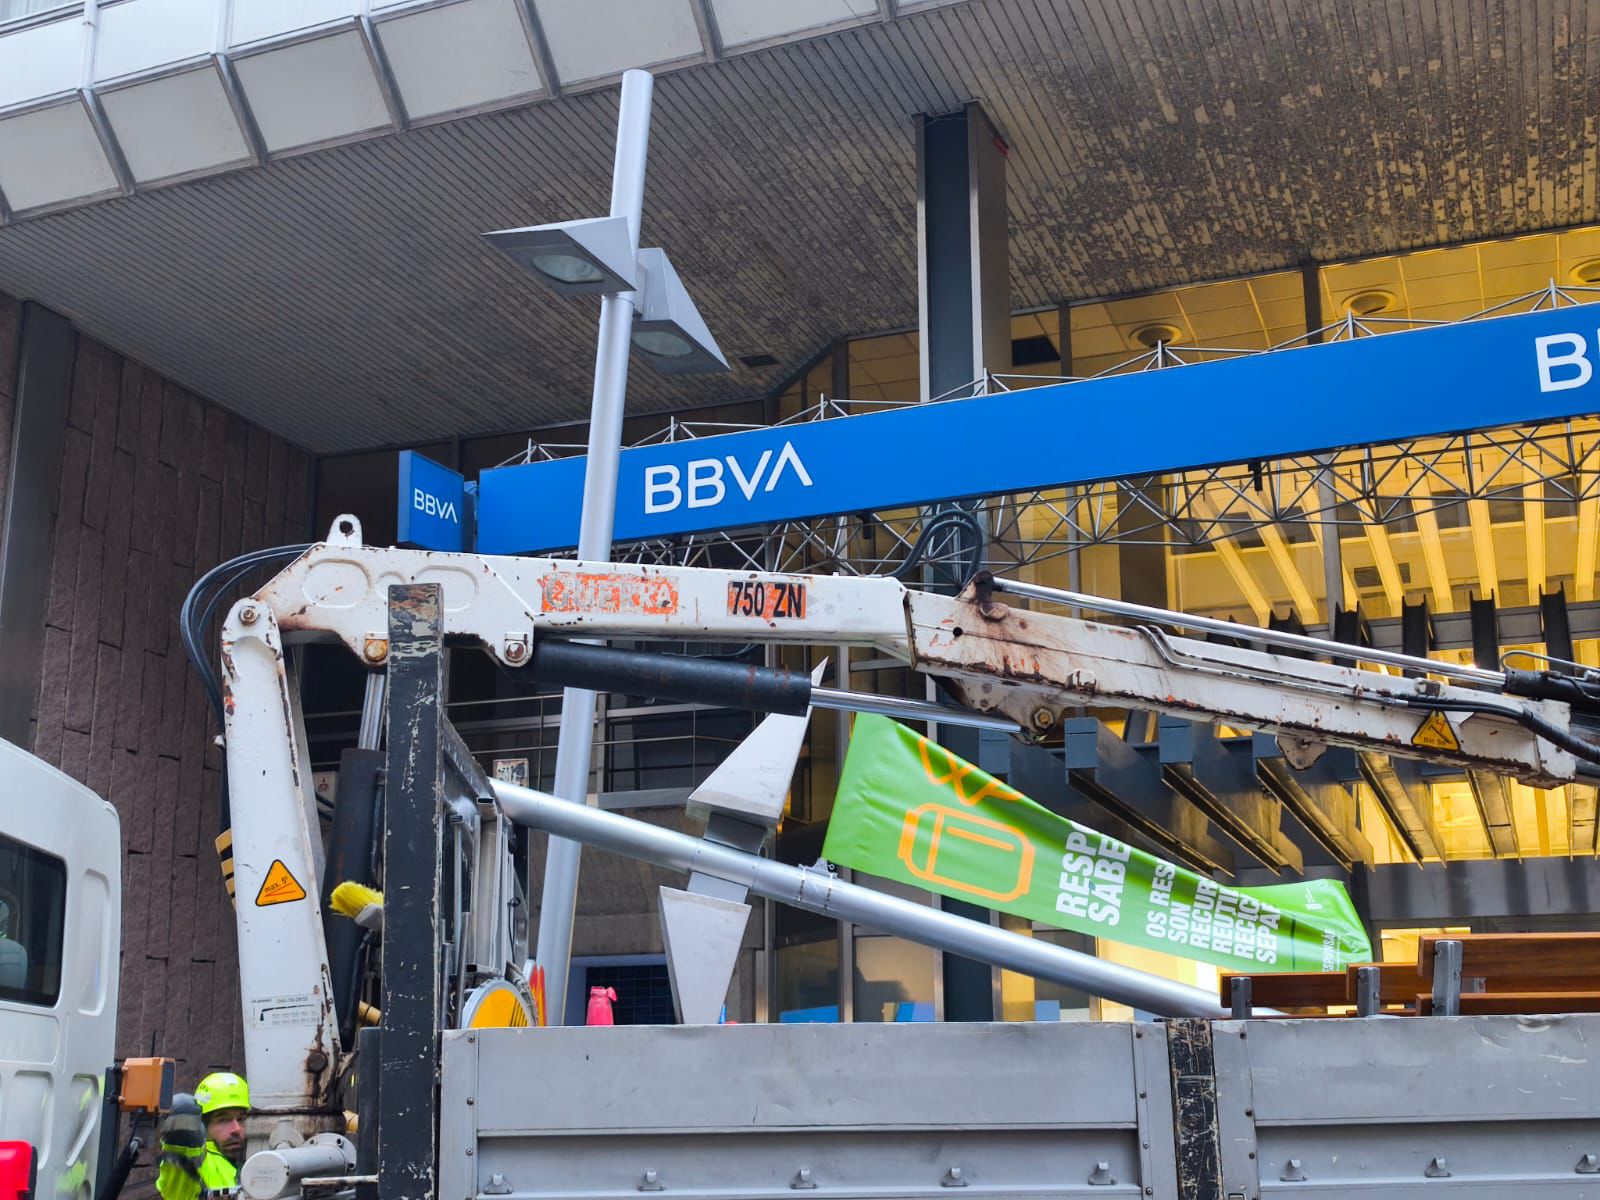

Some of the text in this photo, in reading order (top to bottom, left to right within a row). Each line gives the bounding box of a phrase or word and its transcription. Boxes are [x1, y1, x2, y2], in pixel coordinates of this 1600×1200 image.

[1535, 328, 1600, 393] B
[414, 487, 458, 524] BBVA
[645, 440, 813, 514] BBVA
[732, 581, 802, 618] 750 ZN
[1146, 859, 1176, 938] OS RES
[1168, 901, 1191, 944] SON
[1189, 876, 1218, 949] RECUR
